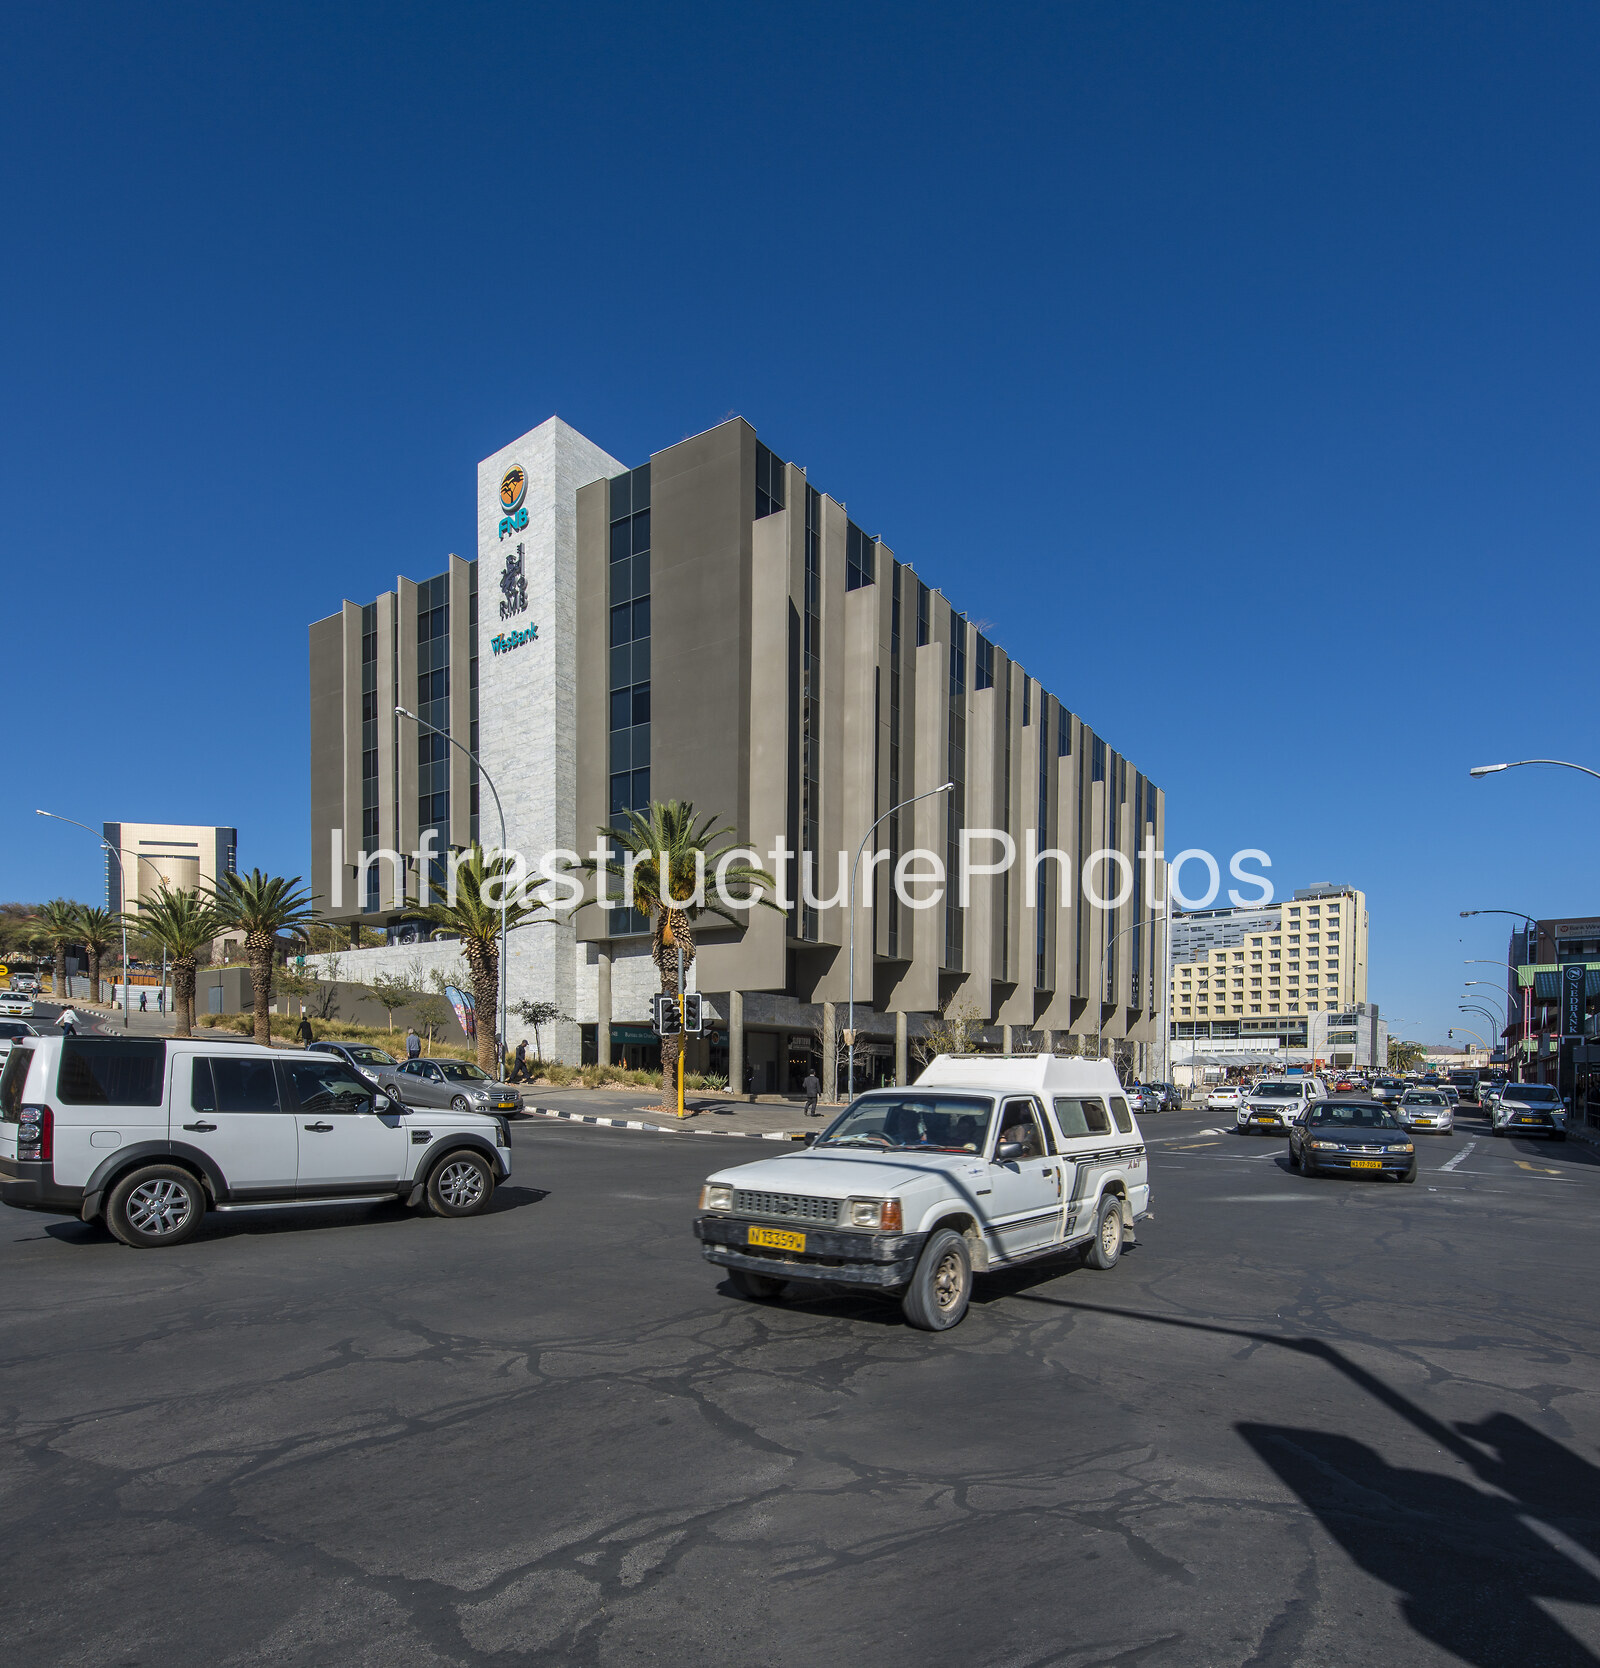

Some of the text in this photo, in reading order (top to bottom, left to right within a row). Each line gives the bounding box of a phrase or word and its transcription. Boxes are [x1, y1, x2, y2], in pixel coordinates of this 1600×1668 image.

[499, 508, 529, 540] FNB
[500, 590, 528, 620] RMB
[491, 621, 538, 656] WesBank
[1569, 982, 1579, 1033] NEDBANK
[1128, 1159, 1141, 1169] XLT
